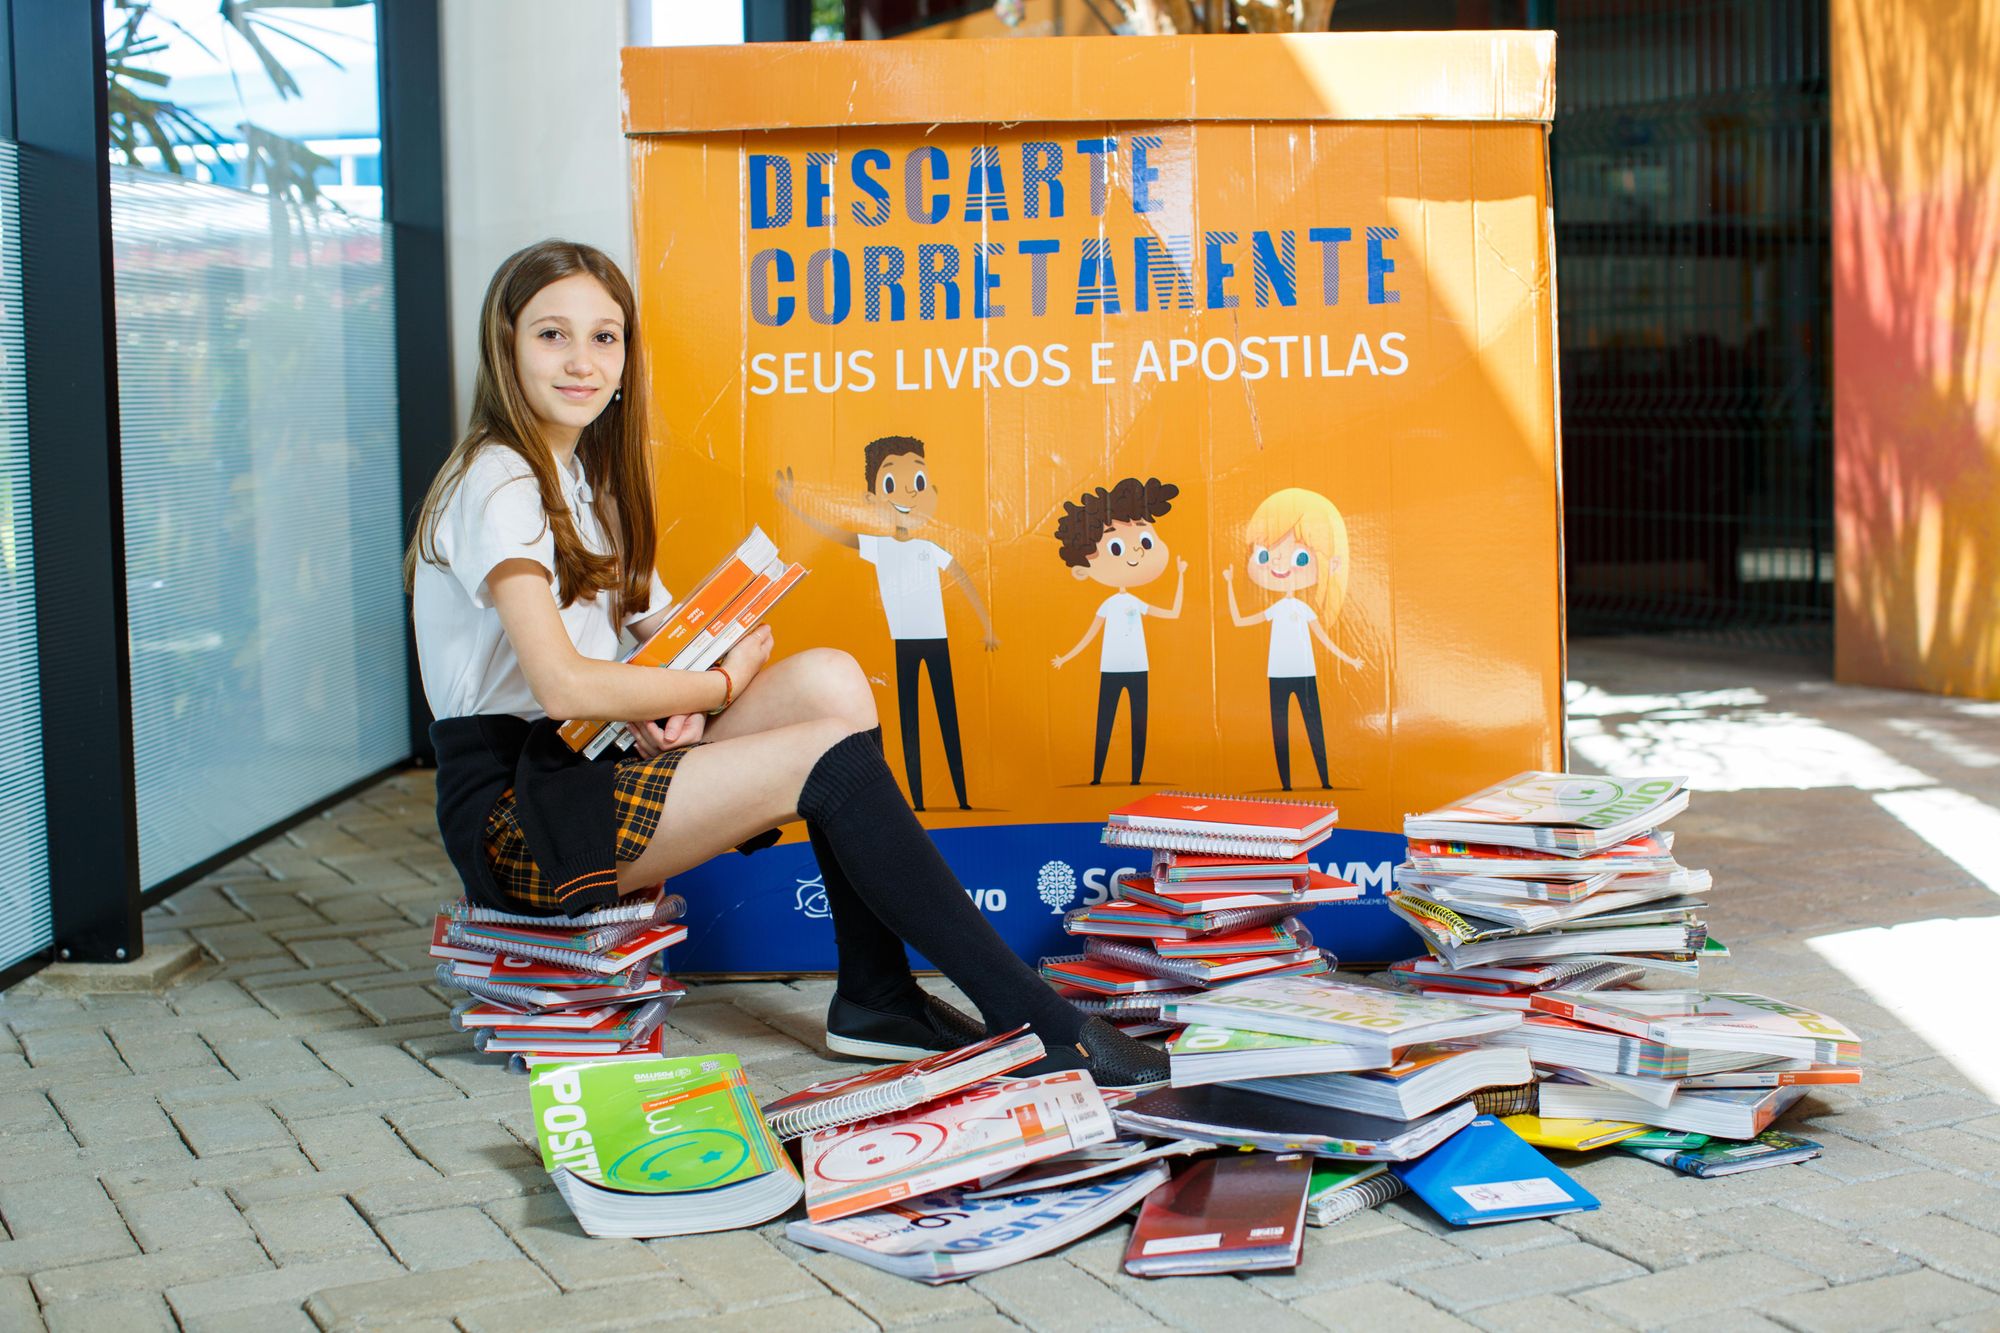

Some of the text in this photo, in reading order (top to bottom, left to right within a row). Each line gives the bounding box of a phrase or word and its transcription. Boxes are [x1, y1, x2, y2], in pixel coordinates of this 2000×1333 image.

[748, 136, 1164, 229] DESCARTE
[749, 226, 1400, 327] CORRETAMENTE
[750, 332, 1410, 395] SEUS LIVROS E APOSTILAS
[1575, 781, 1675, 825] SITIVO
[1344, 898, 1389, 906] MANAGEMEN
[538, 1071, 605, 1184] POSITI
